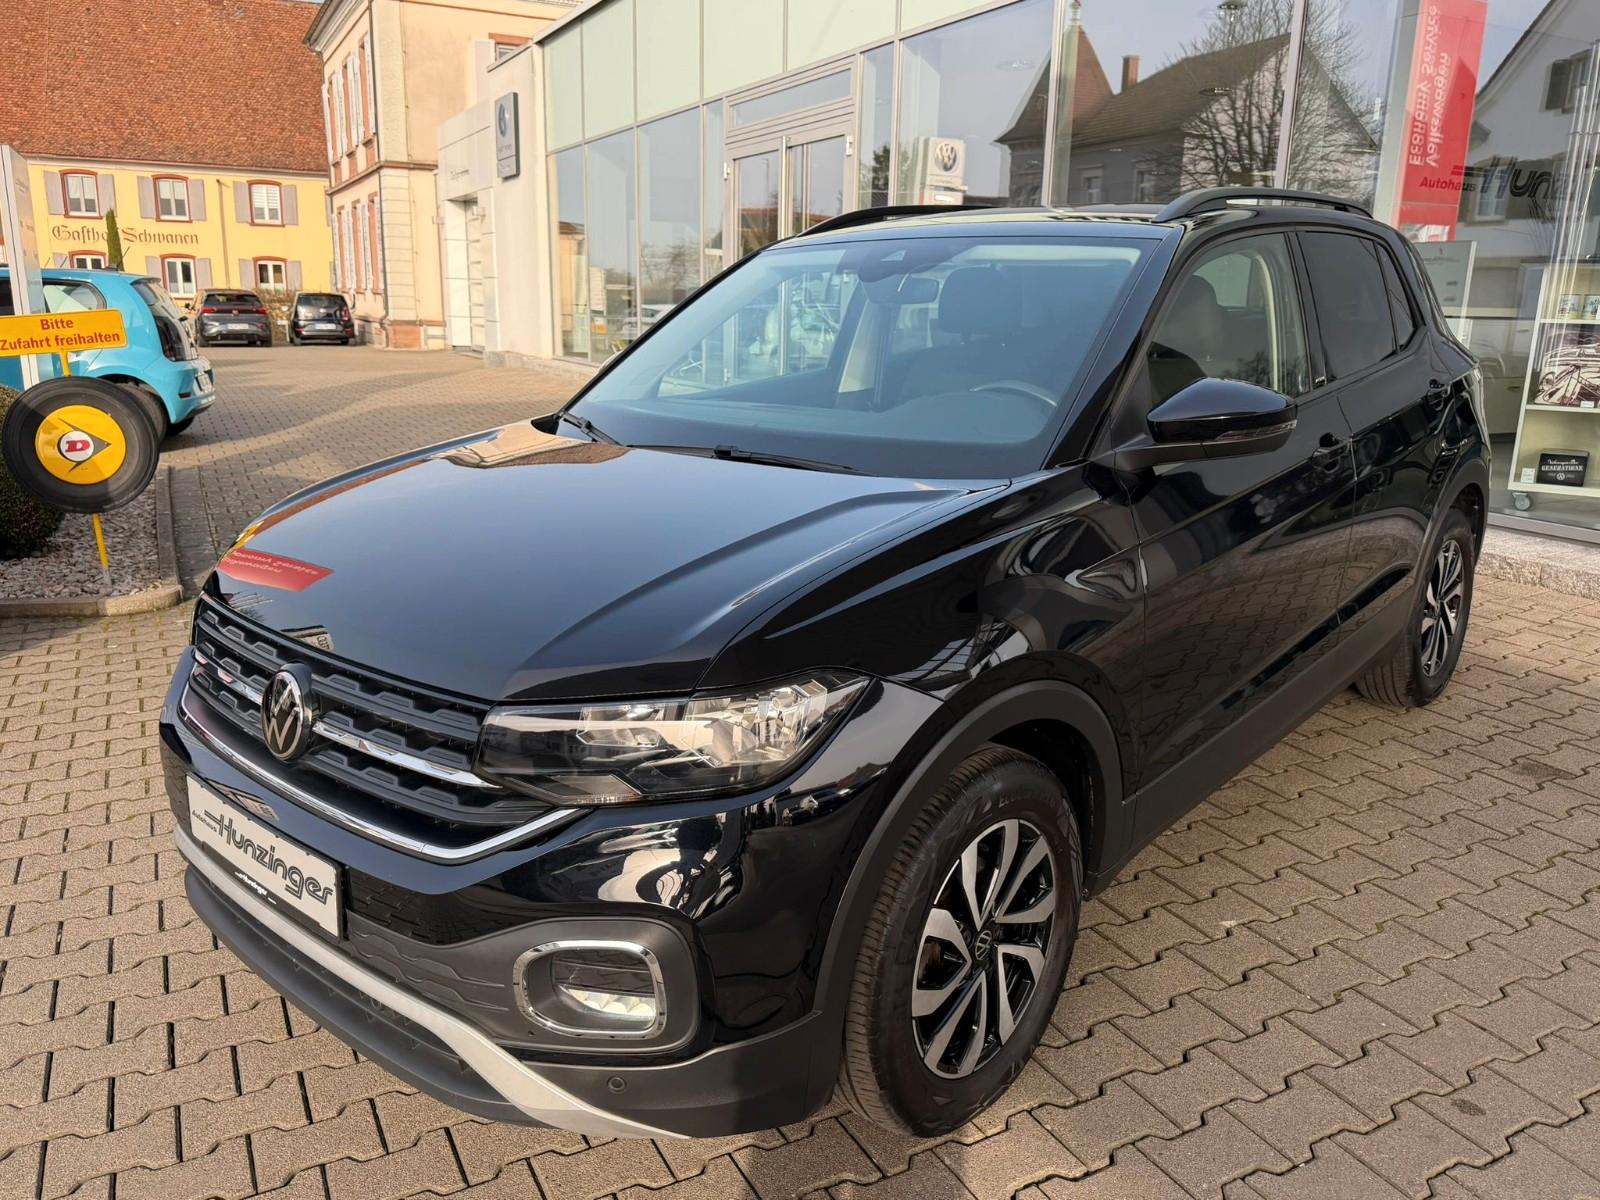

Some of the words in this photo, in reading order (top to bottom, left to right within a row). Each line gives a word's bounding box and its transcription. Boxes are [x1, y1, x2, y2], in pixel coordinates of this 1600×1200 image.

[1419, 176, 1475, 192] Autohaus
[52, 225, 108, 244] Gastho
[121, 227, 199, 245] Schwanen
[40, 318, 74, 330] Bitte
[0, 336, 52, 351] Zufahrt
[54, 332, 121, 346] freihalten
[64, 439, 91, 453] D
[204, 809, 333, 905] Hunzinger
